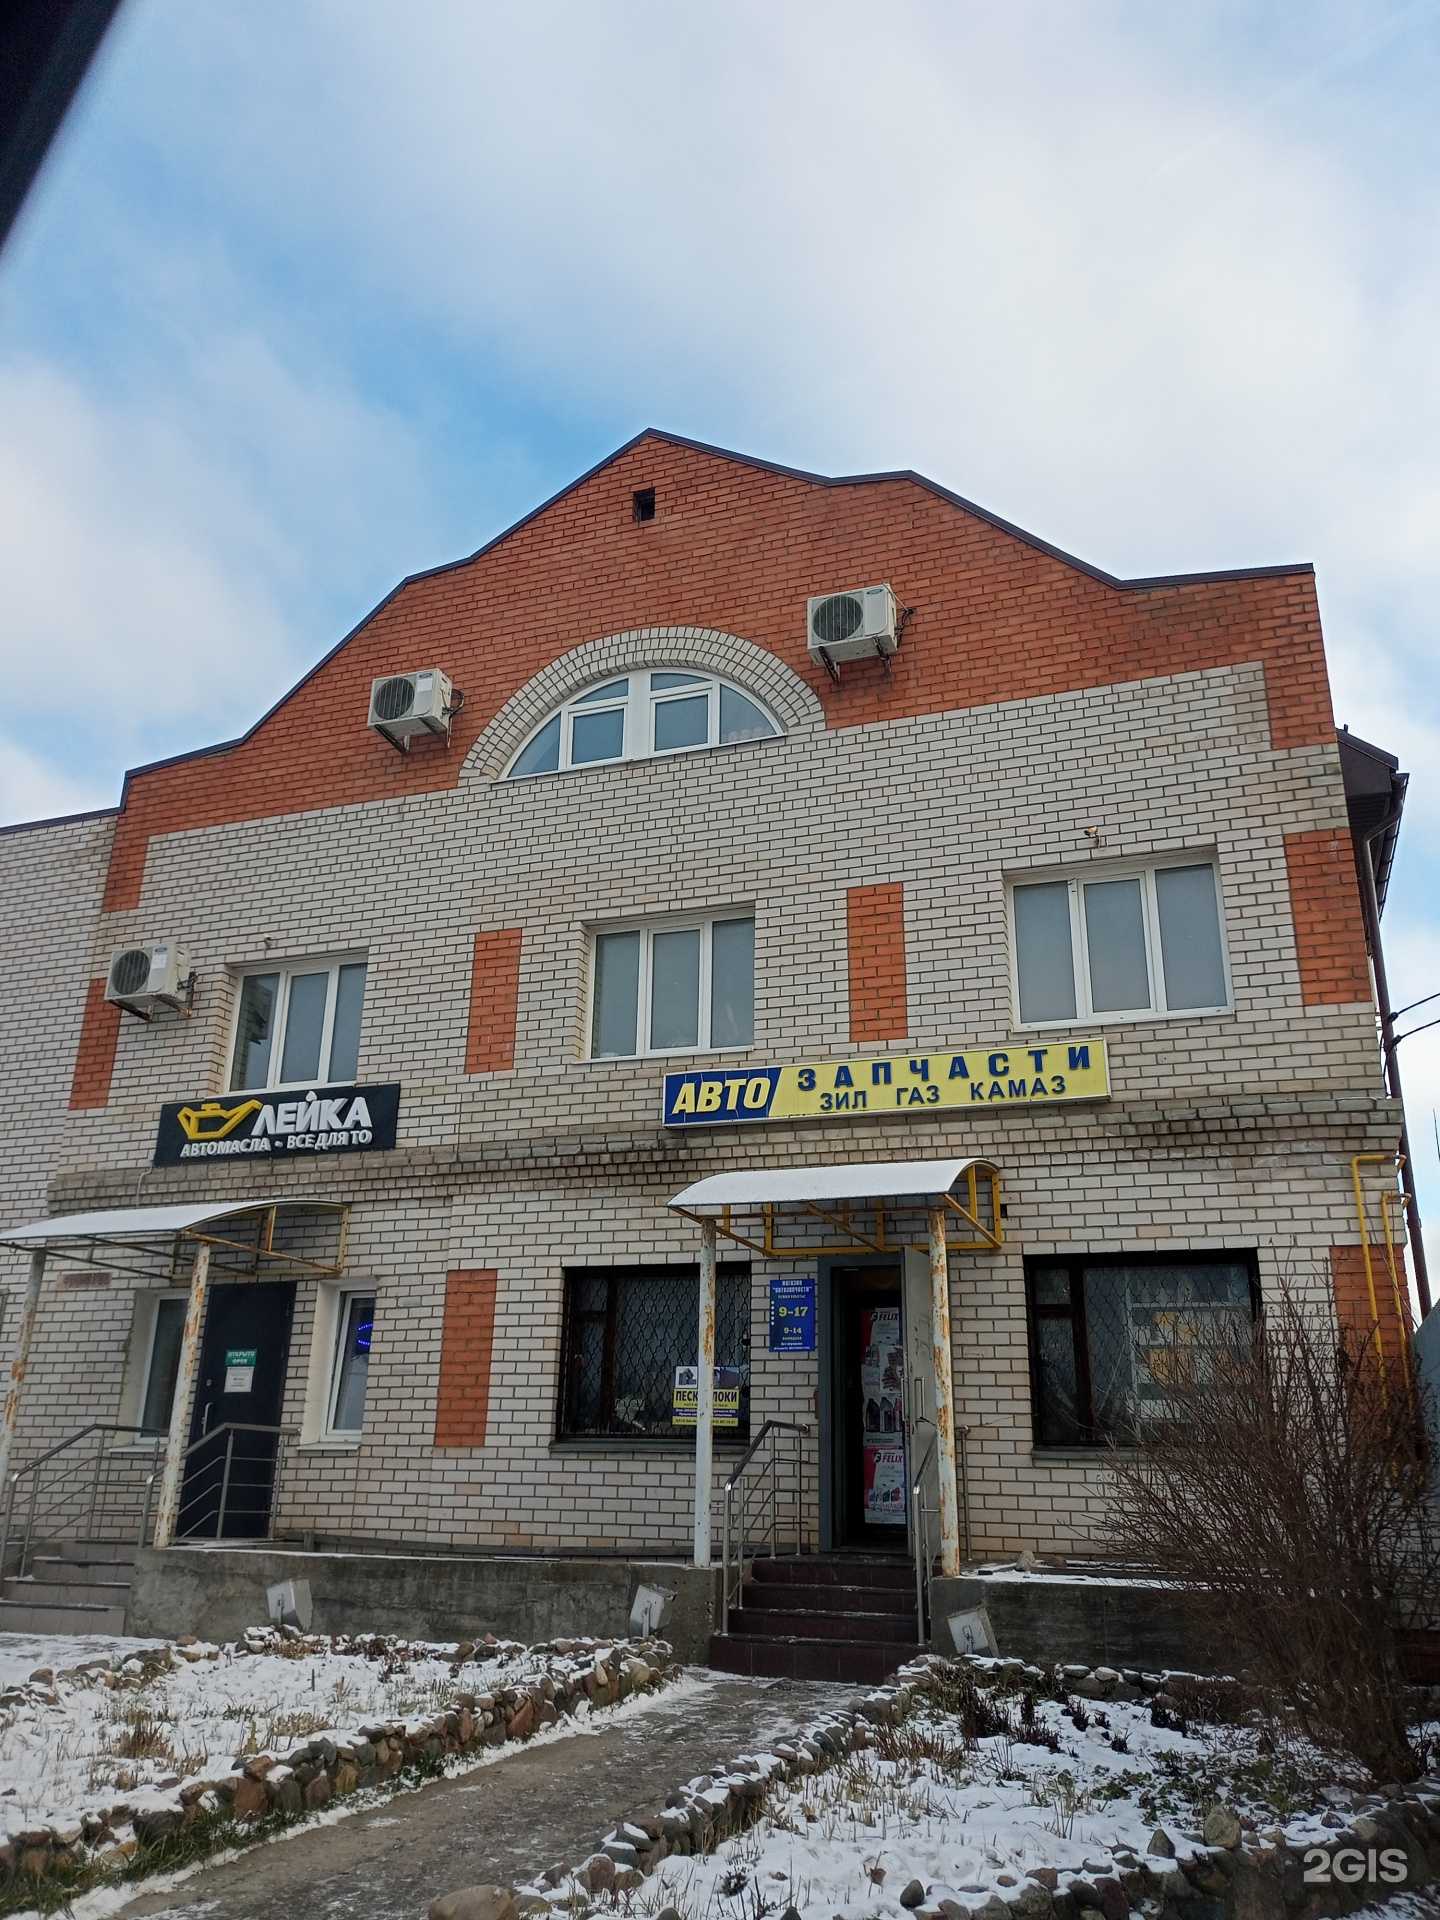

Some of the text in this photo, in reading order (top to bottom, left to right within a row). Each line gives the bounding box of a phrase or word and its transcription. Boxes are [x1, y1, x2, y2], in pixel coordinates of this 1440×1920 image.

[797, 1045, 1091, 1092] ЗАПЧАСТИ
[672, 1077, 772, 1115] АВТО
[819, 1074, 1067, 1112] ЗИЛ ГАЗ КАМАЗ
[251, 1091, 373, 1136] ЛЕЙКА
[180, 1137, 271, 1158] АВТОМАСЛА
[287, 1134, 316, 1149] ВСЕ
[315, 1131, 350, 1150] ДЛЯ
[350, 1129, 373, 1145] ТО
[778, 1306, 808, 1317] 9-17
